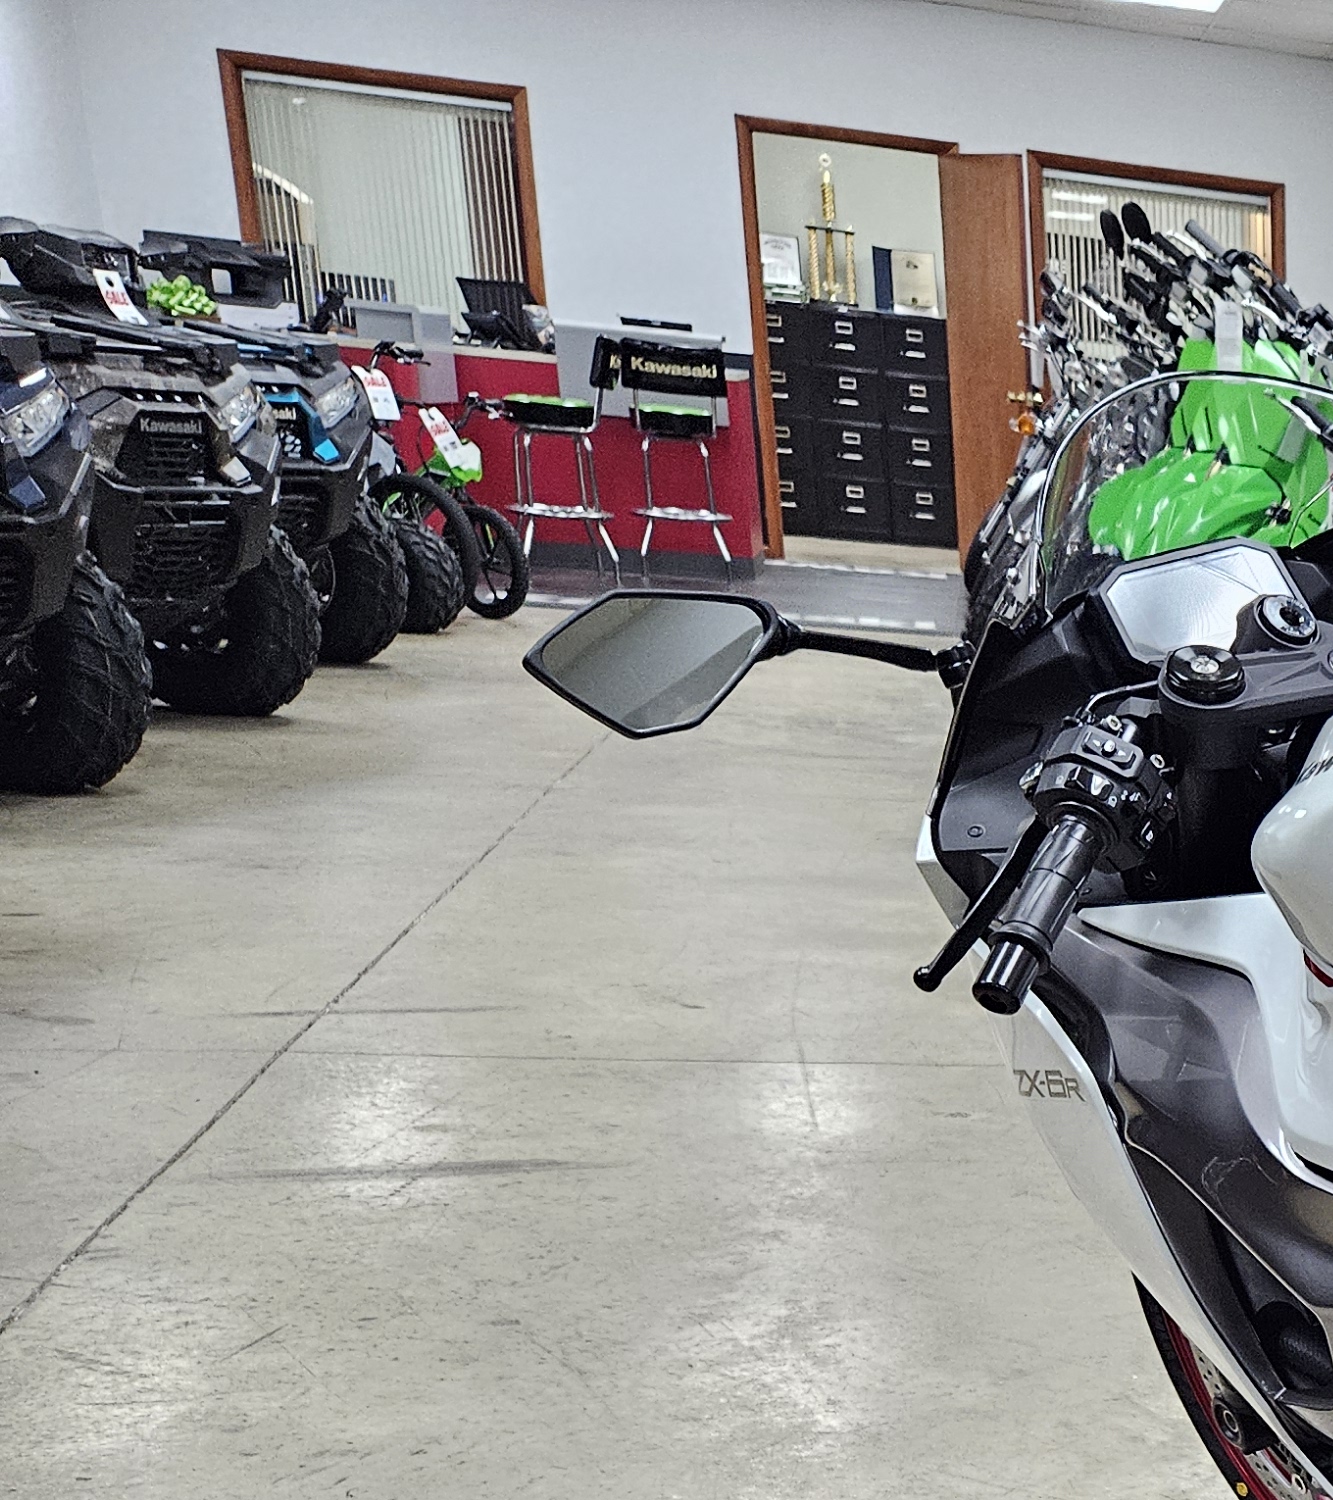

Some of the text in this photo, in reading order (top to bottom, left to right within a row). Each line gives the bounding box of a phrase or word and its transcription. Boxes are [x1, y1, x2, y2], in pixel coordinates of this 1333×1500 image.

[630, 356, 718, 380] Kawasaki
[140, 419, 203, 434] Kawasaki
[1012, 1068, 1087, 1103] ZX-6R
